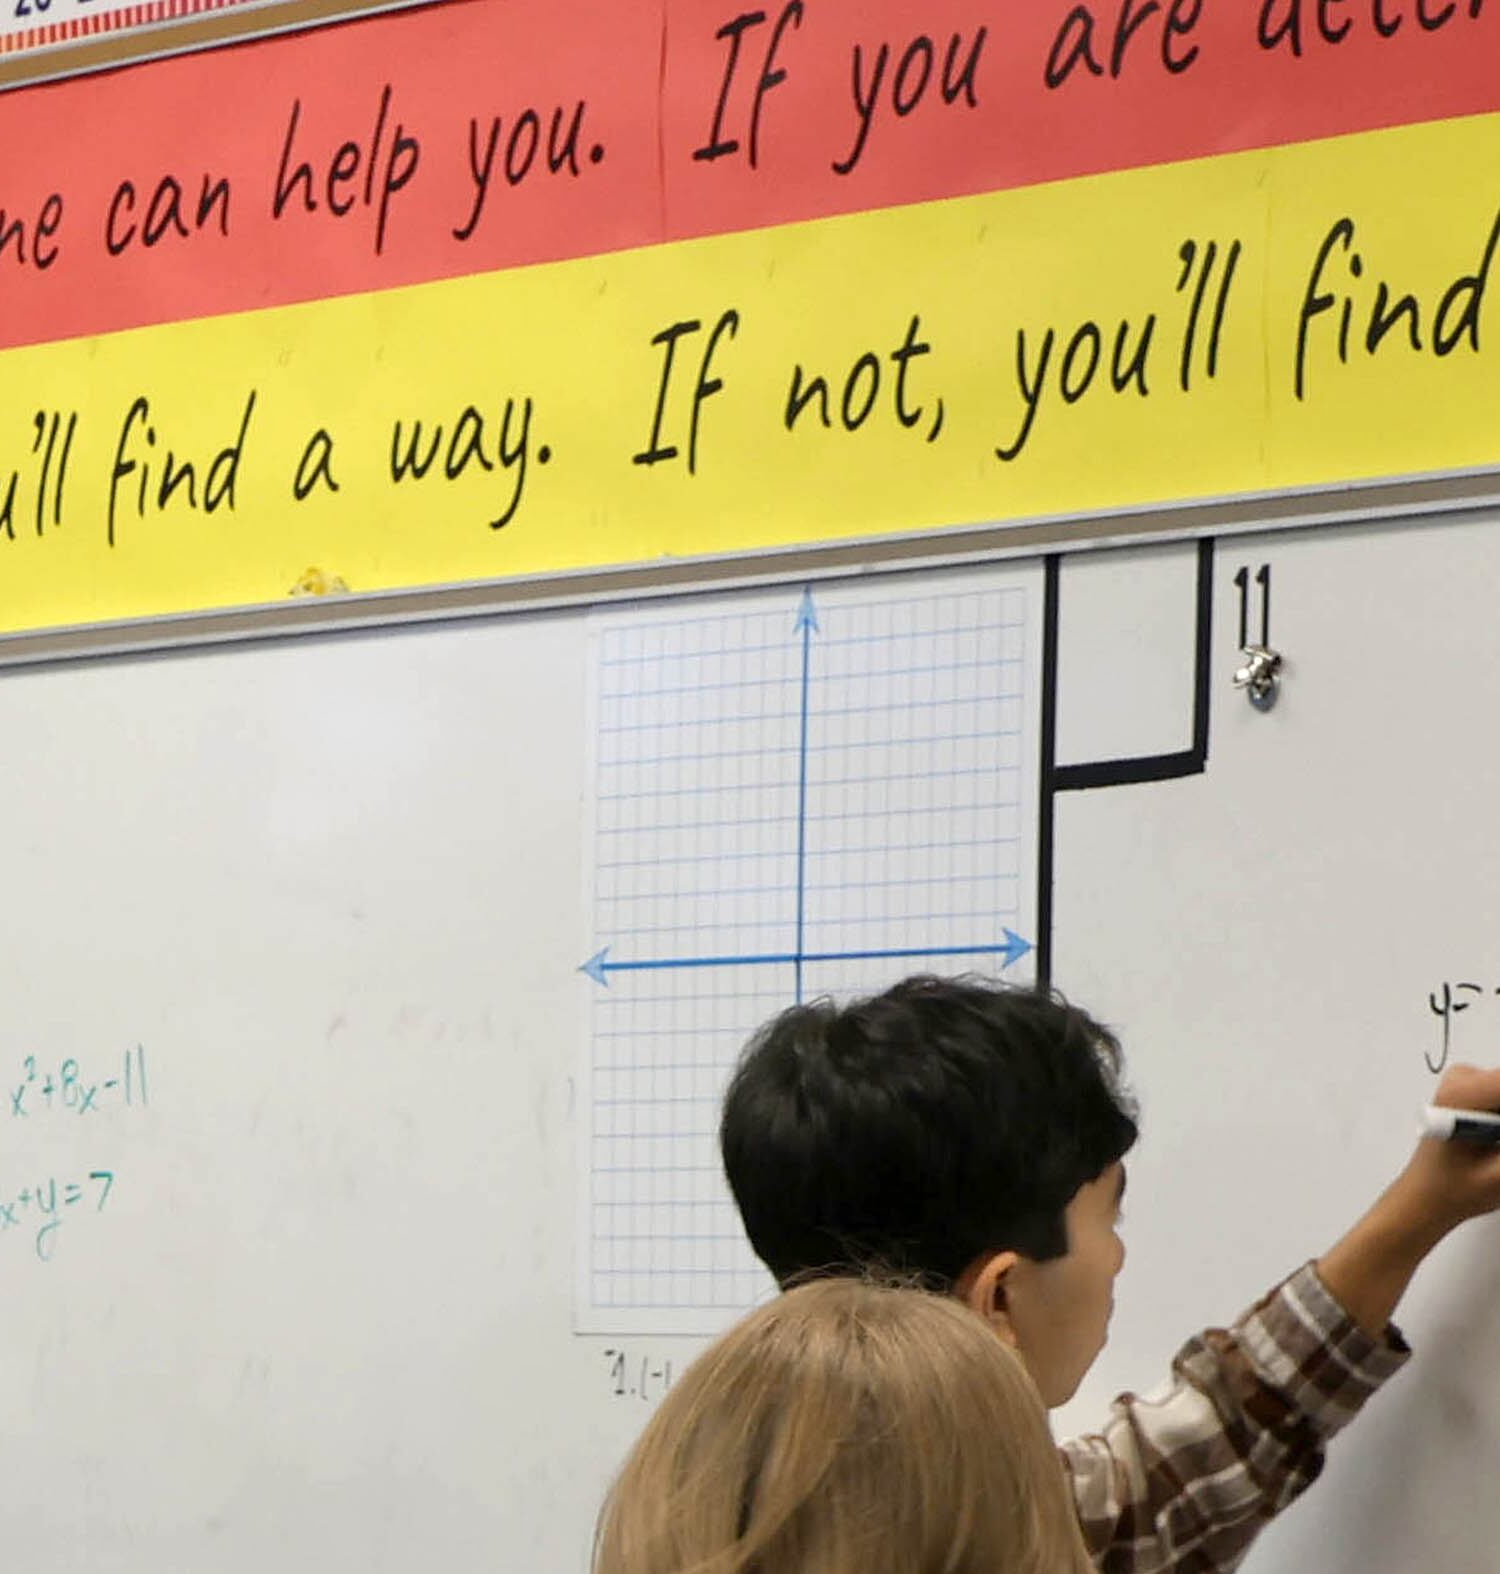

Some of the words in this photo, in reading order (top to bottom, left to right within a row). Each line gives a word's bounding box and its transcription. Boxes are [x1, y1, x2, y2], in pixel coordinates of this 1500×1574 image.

[106, 173, 232, 257] can
[272, 84, 419, 257] help
[452, 99, 605, 241] you.
[693, 0, 802, 168] If
[832, 25, 986, 174] you
[1044, 0, 1201, 88] are
[109, 389, 257, 547] find
[293, 427, 339, 502] a
[391, 397, 550, 530] way.
[633, 310, 738, 475] If
[785, 315, 944, 443] not,
[996, 240, 1240, 461] you'll
[1295, 207, 1500, 400] find
[1234, 564, 1271, 648] 11
